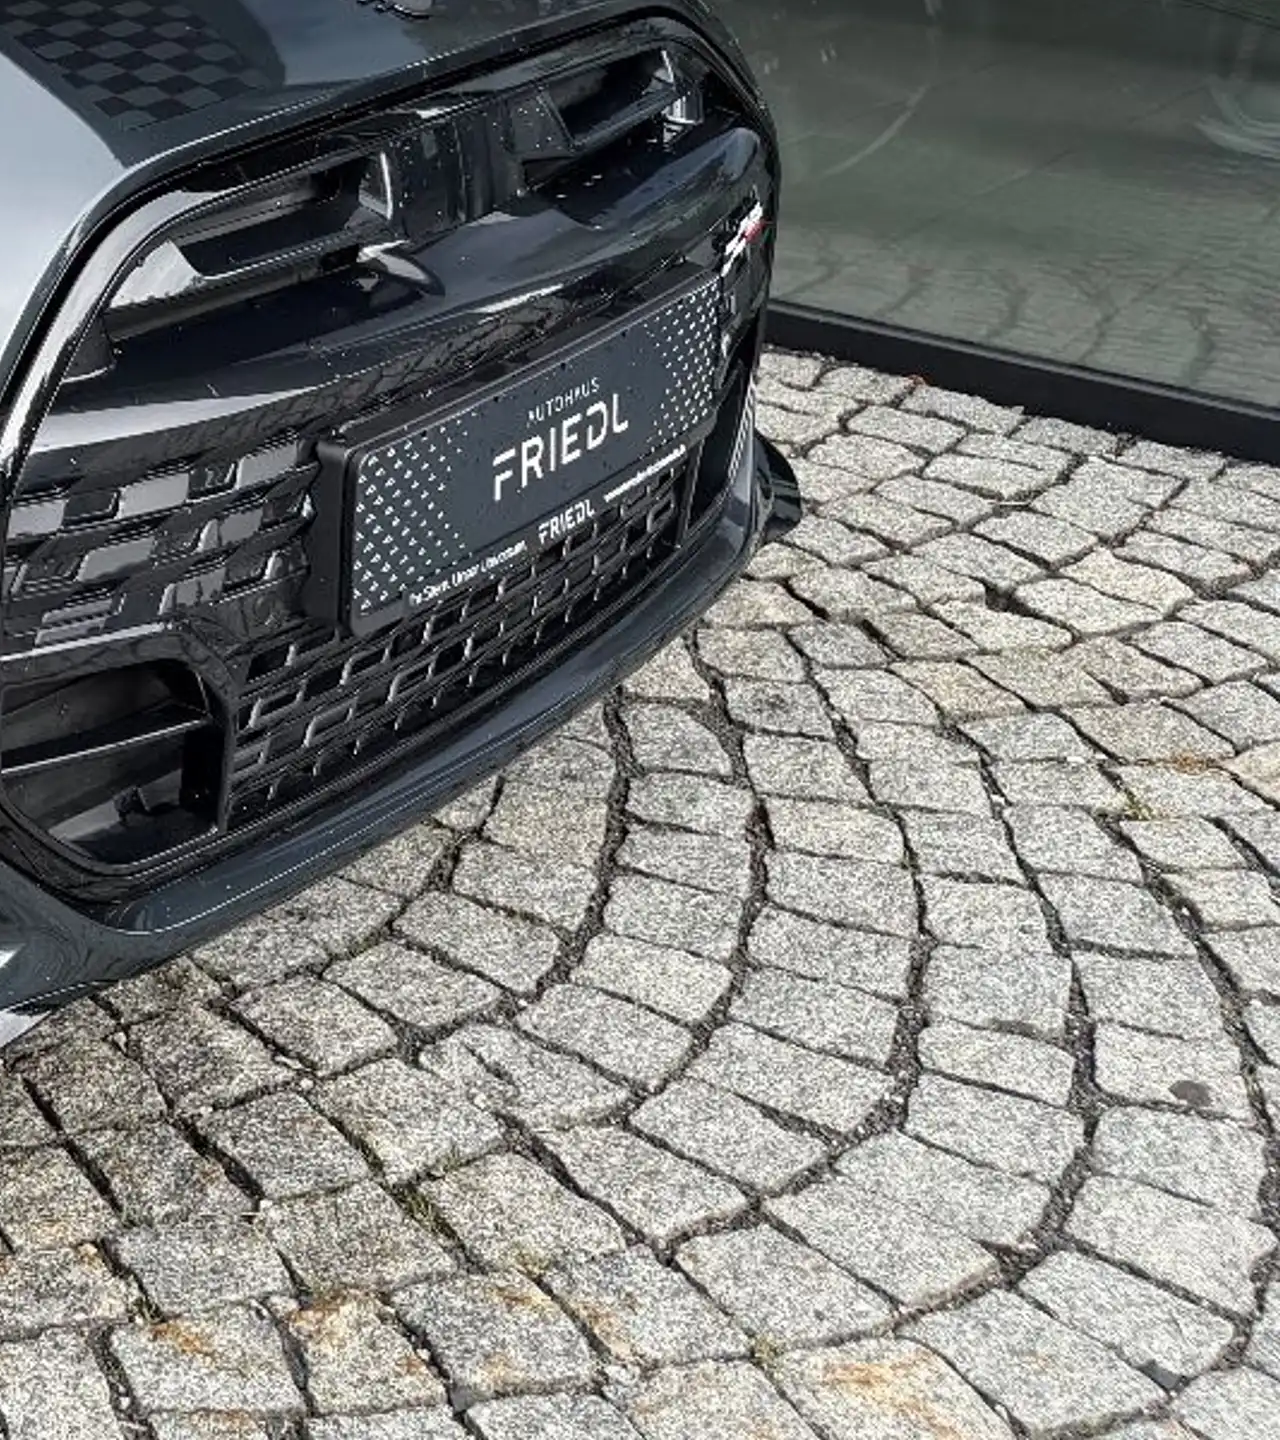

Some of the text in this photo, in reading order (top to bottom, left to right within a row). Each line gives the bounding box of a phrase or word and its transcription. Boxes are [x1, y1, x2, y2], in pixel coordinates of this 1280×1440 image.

[526, 376, 600, 429] AUTOHAUS
[492, 392, 629, 502] FRIEDL
[538, 498, 595, 545] FRIEDL
